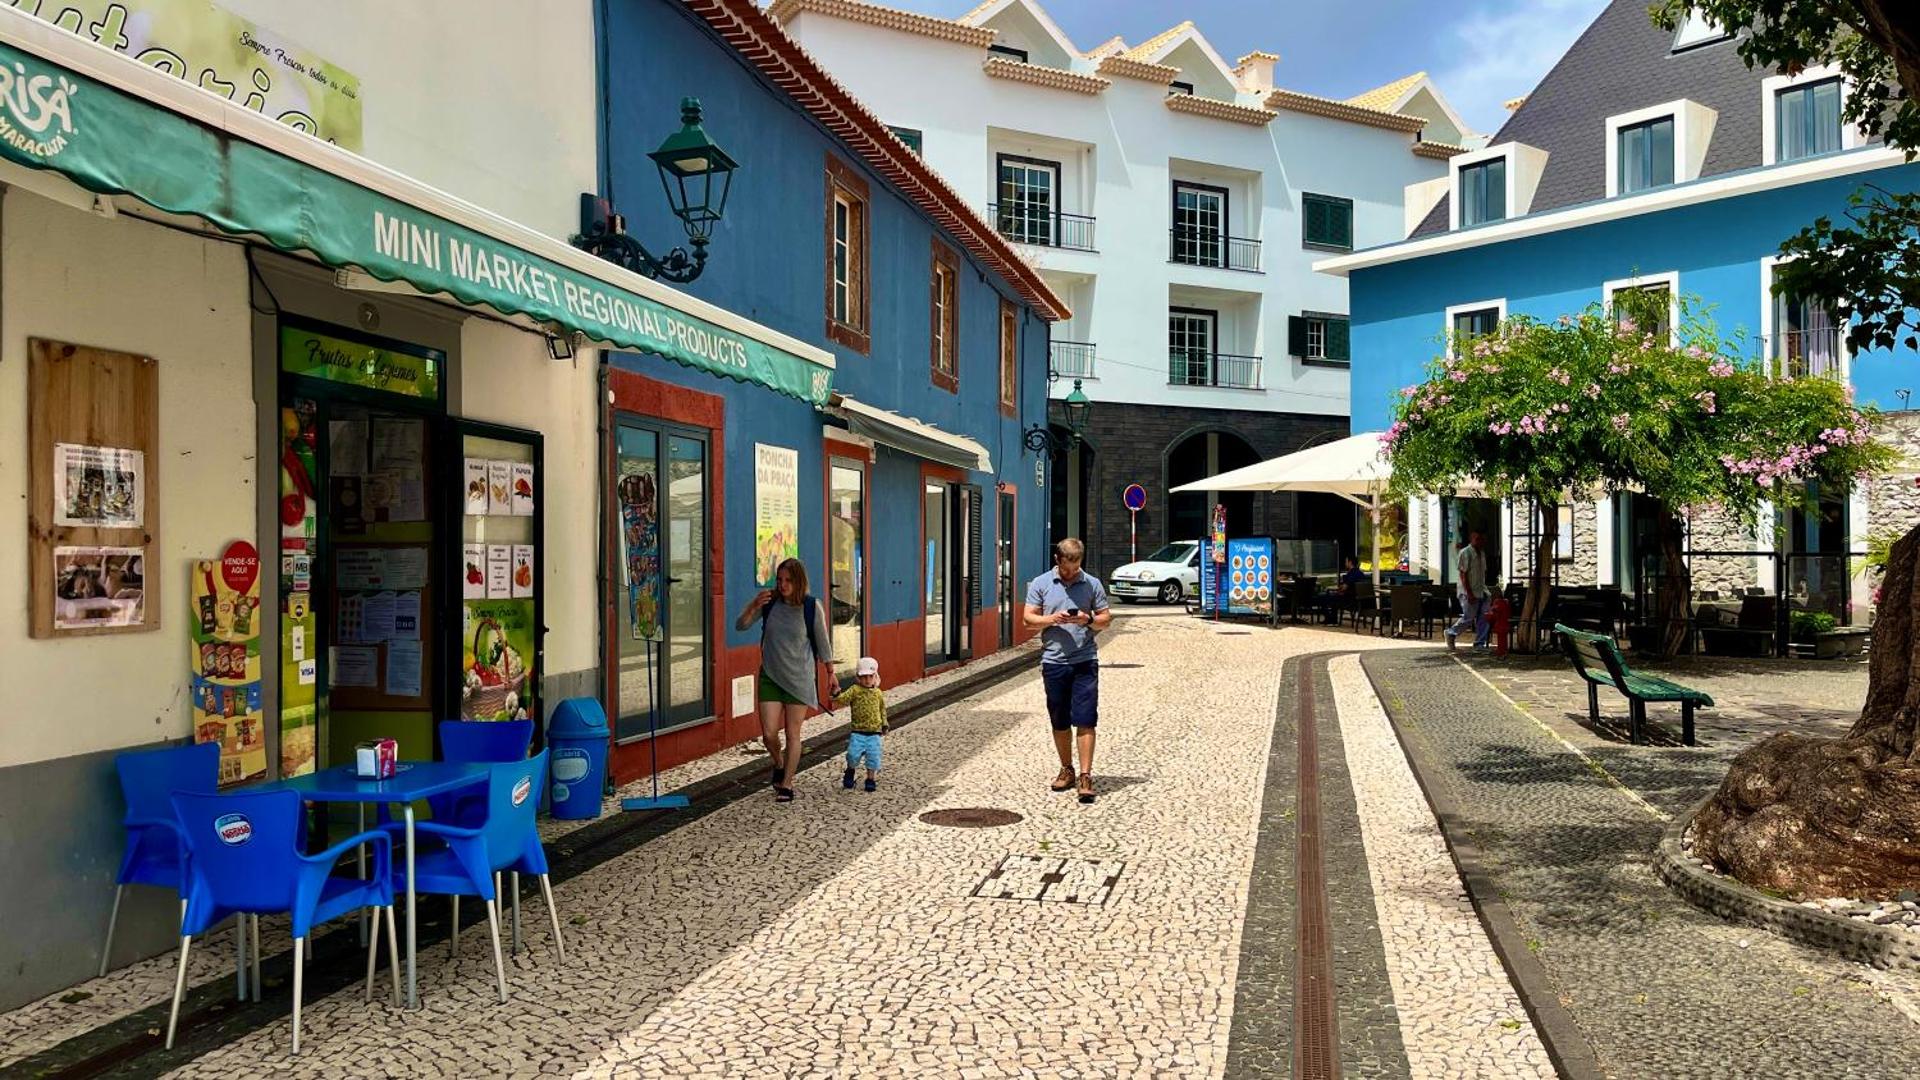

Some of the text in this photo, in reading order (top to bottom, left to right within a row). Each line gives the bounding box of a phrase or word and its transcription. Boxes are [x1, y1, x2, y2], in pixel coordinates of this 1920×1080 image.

[239, 31, 271, 55] Sempre
[274, 48, 305, 73] Frescos
[308, 67, 327, 85] todos
[374, 211, 747, 368] MINI MARKET REGIONAL PRODUCTS
[304, 338, 353, 368] Frutas
[759, 449, 794, 469] PONCHA
[758, 469, 796, 492] DA PRAÇA
[224, 557, 257, 566] VENDE-SE
[301, 667, 314, 676] VISA
